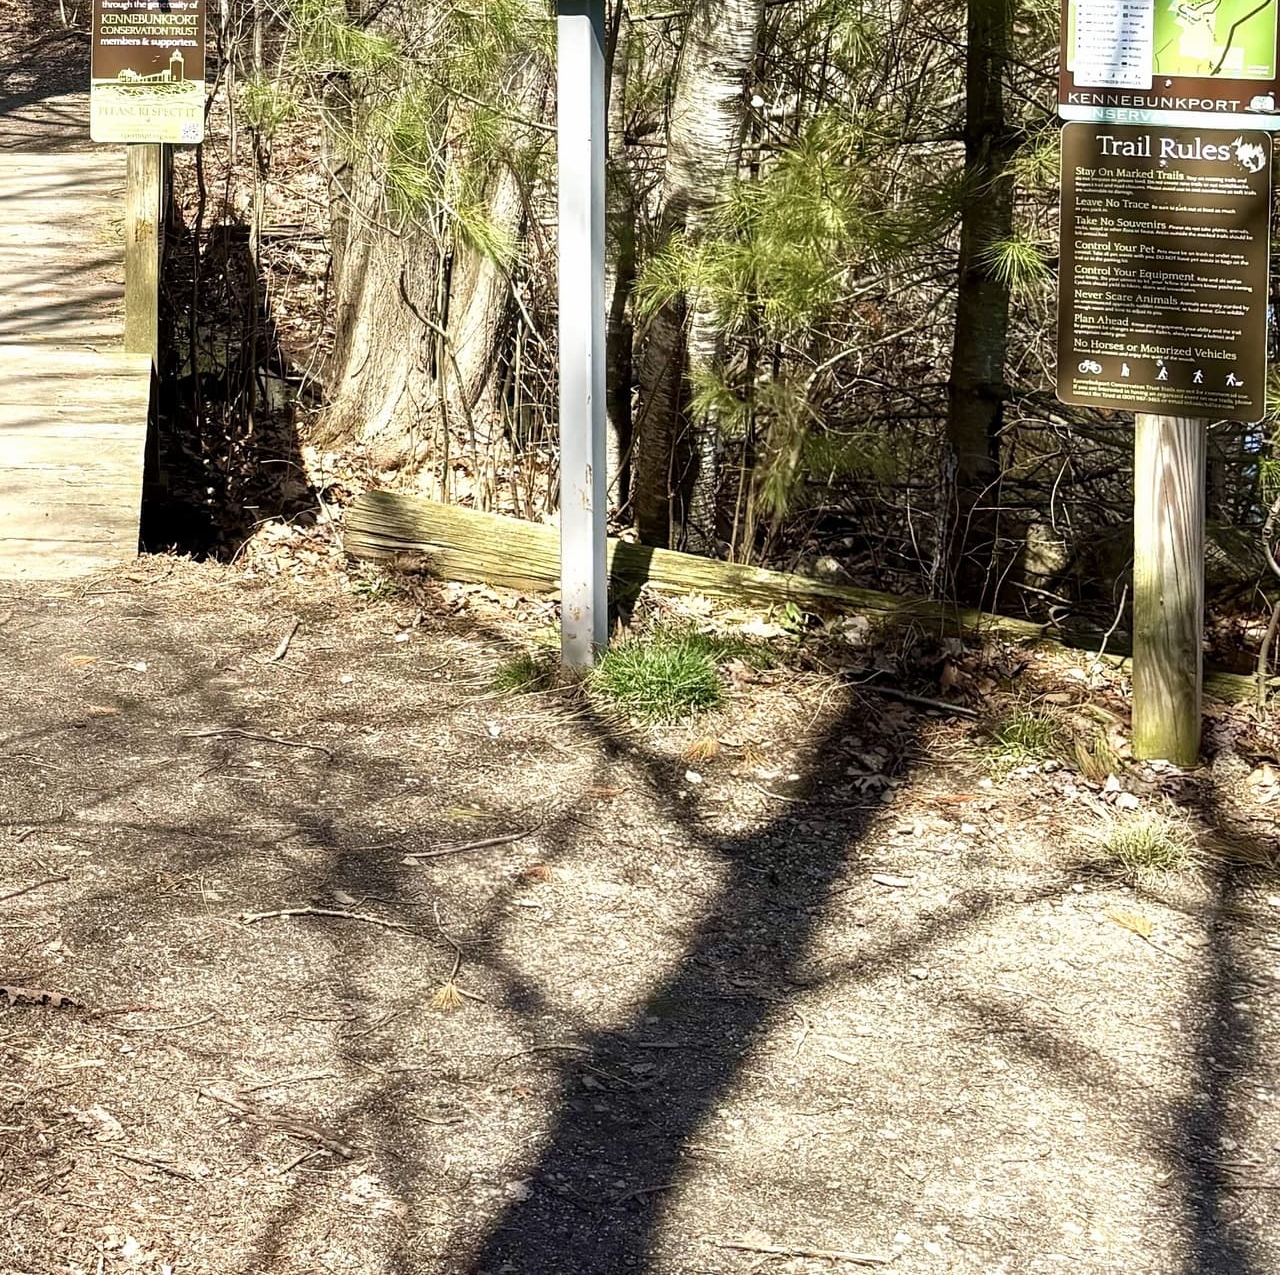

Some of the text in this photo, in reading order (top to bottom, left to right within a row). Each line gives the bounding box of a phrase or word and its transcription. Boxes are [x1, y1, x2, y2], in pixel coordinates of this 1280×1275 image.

[102, 0, 133, 10] through
[134, 0, 146, 8] the
[101, 14, 199, 25] KENNEBUNKPORT
[100, 26, 199, 35] CONSERVATION TRUST
[101, 36, 141, 46] members
[1068, 92, 1241, 112] KENNEBUNKPORT
[99, 106, 136, 116] PLEASE
[1096, 134, 1231, 161] Trail Rules
[1075, 166, 1096, 177] Stay
[1098, 167, 1113, 177] On
[1116, 168, 1154, 179] Marked
[1156, 170, 1184, 180] Trails
[1075, 197, 1103, 207] Leave
[1105, 198, 1120, 208] No
[1121, 199, 1150, 210] Trace
[1074, 216, 1098, 225] Take
[1100, 216, 1115, 226] No
[1117, 218, 1167, 230] Souvenirs
[1074, 240, 1111, 251] Control
[1113, 242, 1137, 253] Your
[1139, 244, 1155, 254] Pet
[1074, 264, 1111, 275] Control
[1113, 266, 1137, 277] Your
[1139, 269, 1195, 282] Equipment
[1074, 289, 1103, 300] Never
[1105, 291, 1133, 303] Scare
[1135, 294, 1178, 305] Animals
[1074, 313, 1095, 324] Plan
[1096, 315, 1129, 327] Ahead
[1074, 338, 1088, 348] No
[1090, 339, 1124, 351] Horses
[1126, 343, 1138, 352] or
[1140, 343, 1192, 357] Motorized
[1194, 348, 1237, 360] Vehicles
